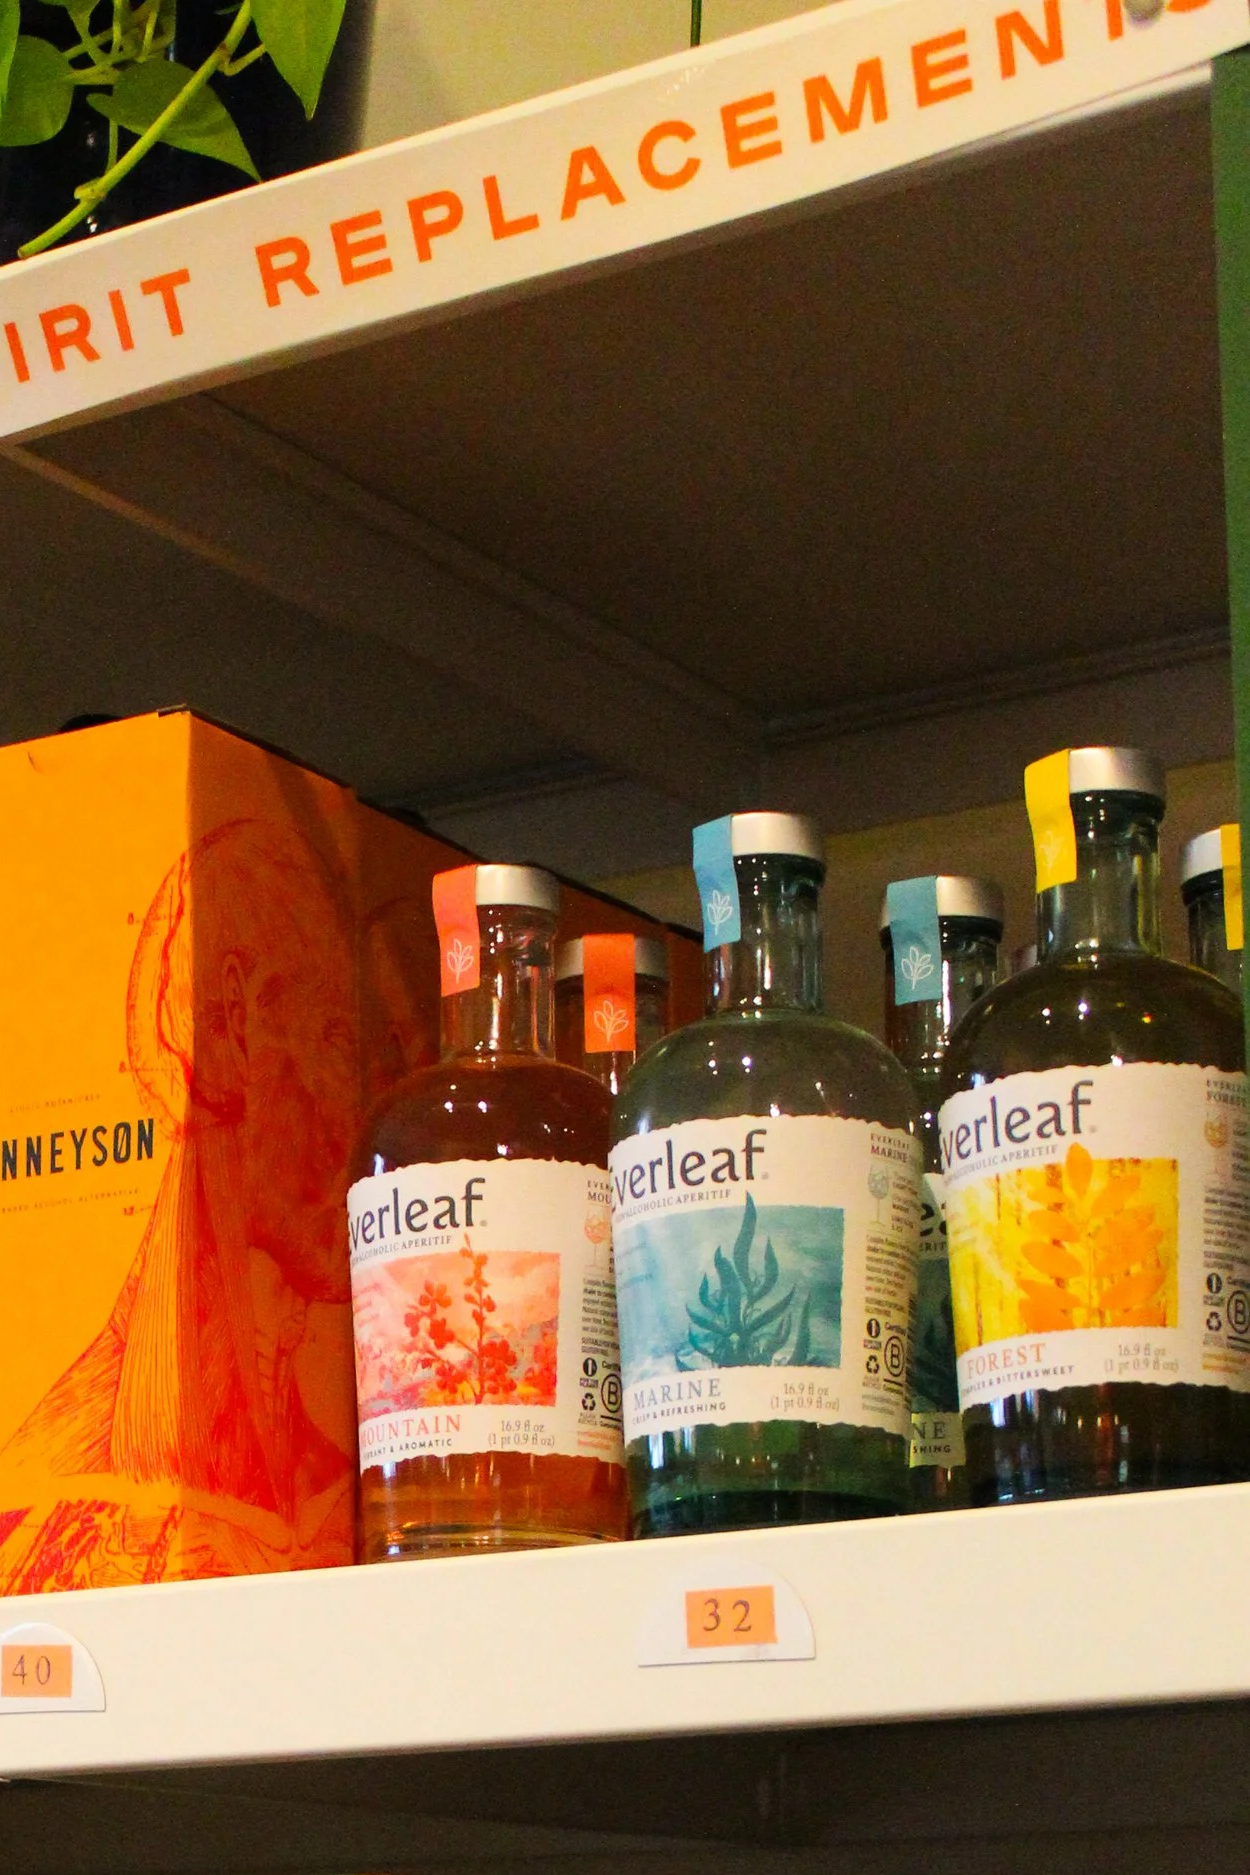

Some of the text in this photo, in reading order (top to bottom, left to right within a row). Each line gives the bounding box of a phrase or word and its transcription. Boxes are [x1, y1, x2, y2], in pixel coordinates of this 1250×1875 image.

[255, 0, 1213, 308] REPLACEMEN
[939, 1080, 1094, 1169] verleaf
[870, 1144, 908, 1164] MARINE
[1001, 1144, 1059, 1164] APERITIF
[611, 1128, 768, 1211] verleaf
[675, 1188, 732, 1205] APERITIF
[348, 1177, 486, 1249] verleaf
[401, 1235, 452, 1250] APERITIF
[967, 1342, 1047, 1380] FOREST
[997, 1364, 1075, 1384] BITTERSWEET
[633, 1377, 722, 1411] MARINE
[783, 1383, 829, 1396] 16.9 oz
[661, 1402, 726, 1418] REFRESHING
[501, 1420, 544, 1432] 16.9 oz
[399, 1438, 452, 1450] AROMATIC
[703, 1597, 753, 1632] 32
[10, 1655, 53, 1687] 40
